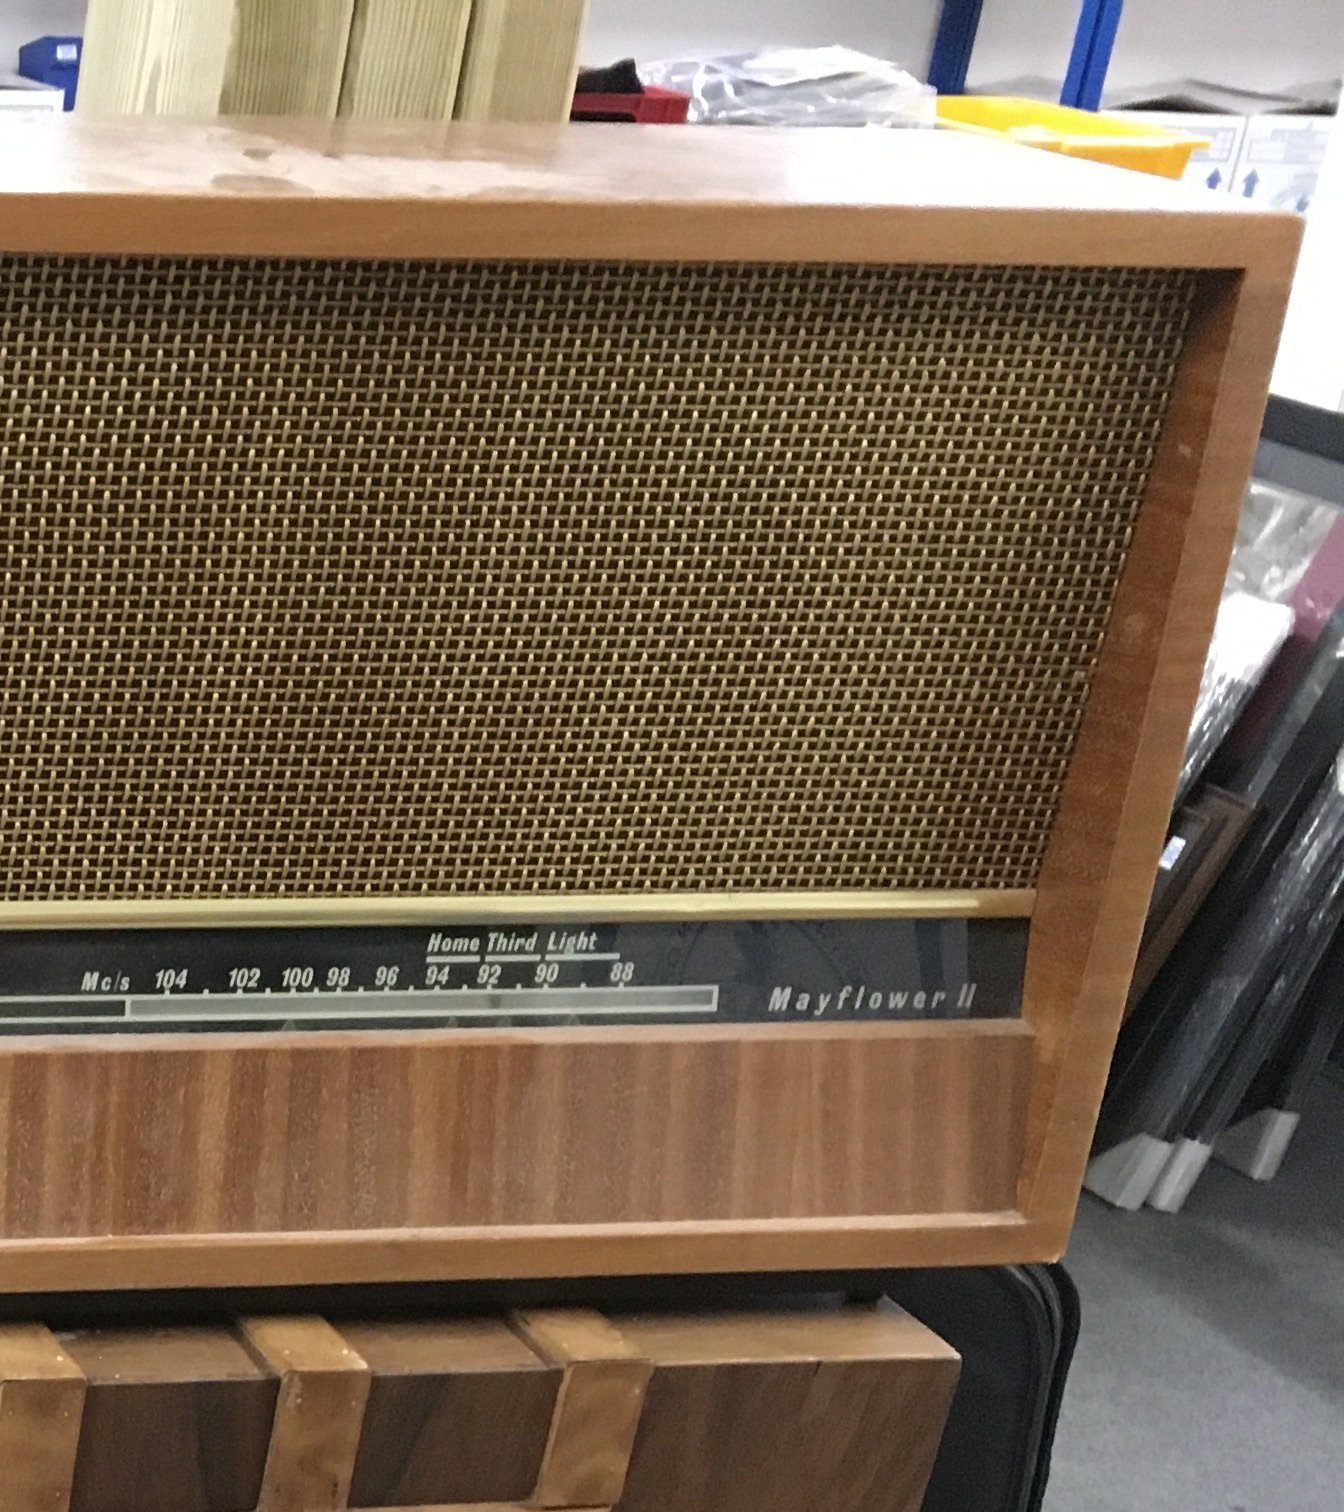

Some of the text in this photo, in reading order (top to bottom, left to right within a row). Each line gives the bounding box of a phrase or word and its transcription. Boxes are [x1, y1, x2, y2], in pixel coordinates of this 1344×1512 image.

[424, 930, 597, 954] Home Third Light
[154, 968, 188, 990] 104
[228, 967, 261, 988] 102
[280, 966, 314, 987] 100
[324, 966, 350, 986] 98
[373, 965, 399, 985] 96
[423, 963, 449, 983] 94
[474, 962, 500, 982] 92
[533, 961, 557, 981] 90
[608, 960, 635, 980] 88
[765, 983, 949, 1016] Mayflower
